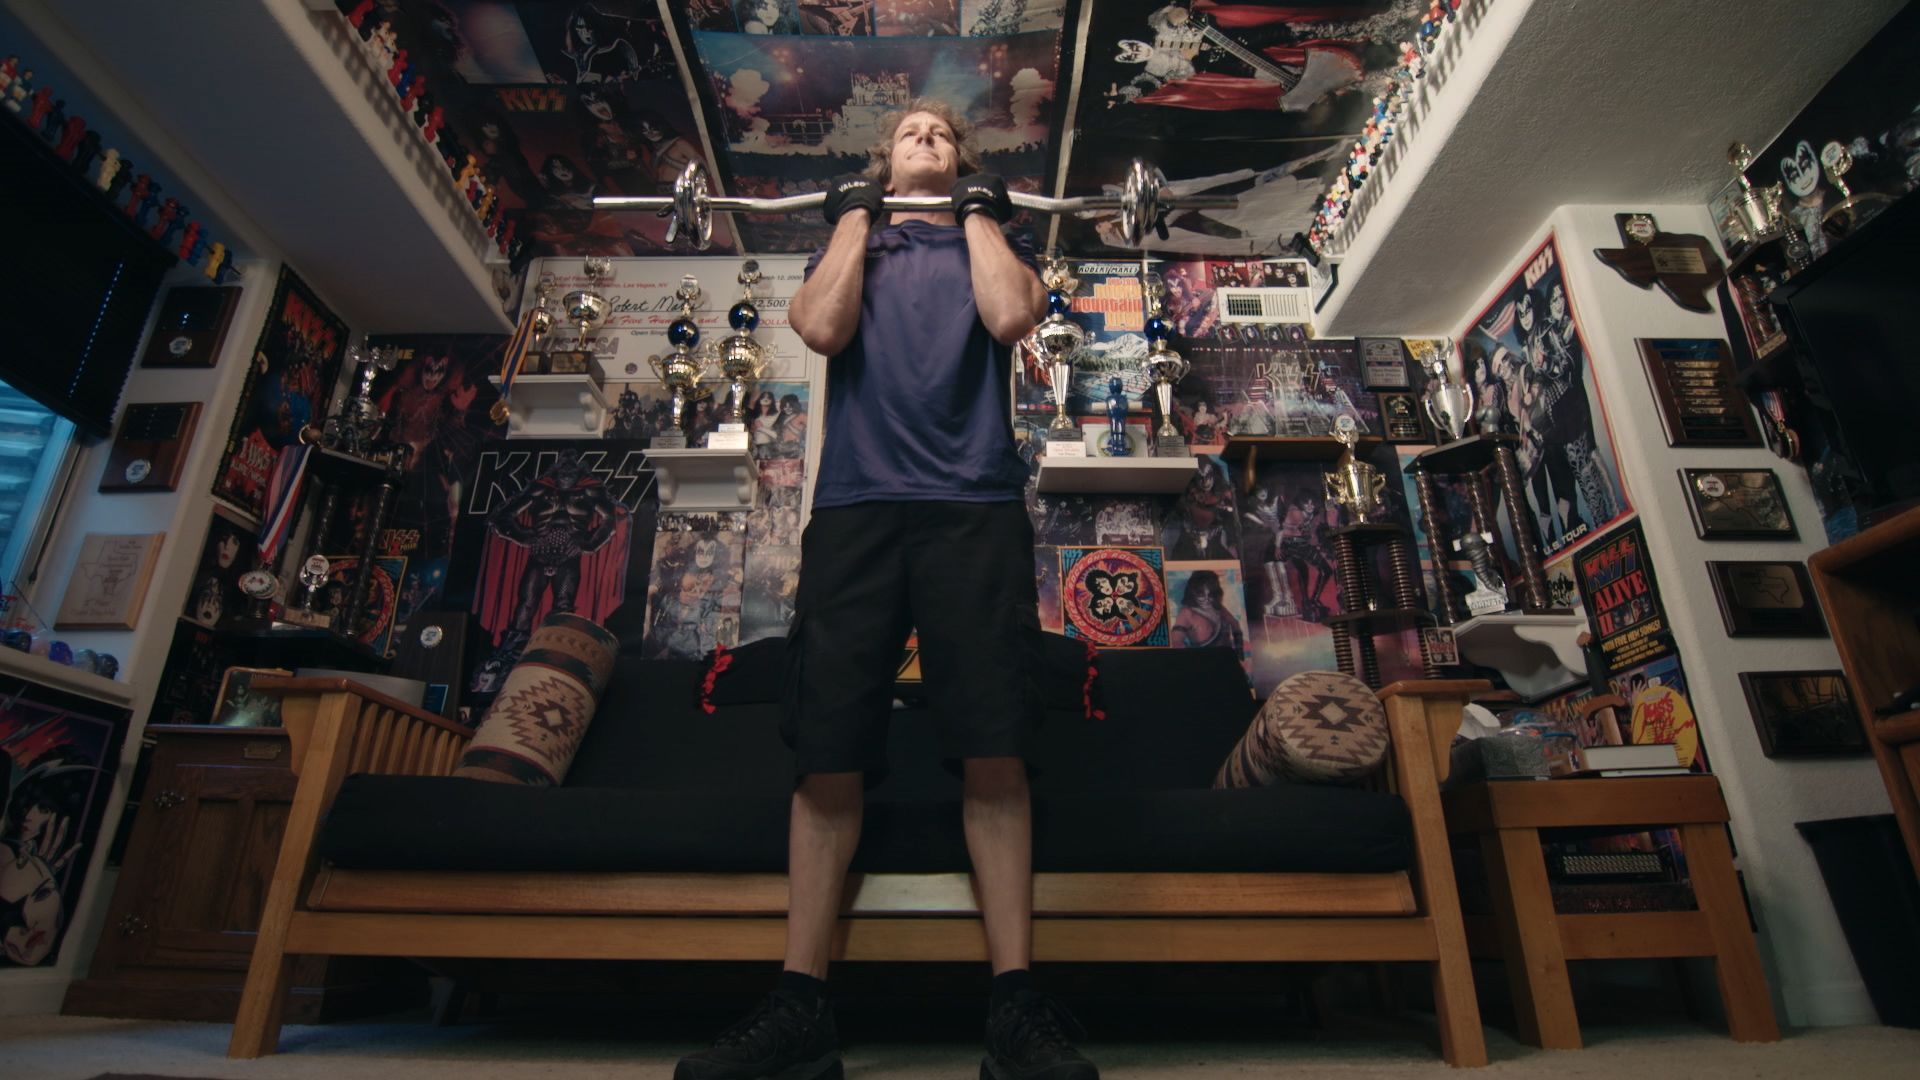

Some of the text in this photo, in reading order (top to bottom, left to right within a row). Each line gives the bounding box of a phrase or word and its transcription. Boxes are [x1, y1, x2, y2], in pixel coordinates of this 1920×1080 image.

[499, 87, 566, 112] KISS
[838, 181, 869, 193] VALEO
[967, 185, 996, 198] VALEO
[1524, 245, 1554, 290] KISS
[1562, 522, 1588, 546] TOUR
[1581, 536, 1637, 593] KISS
[1594, 570, 1650, 614] ALIVE
